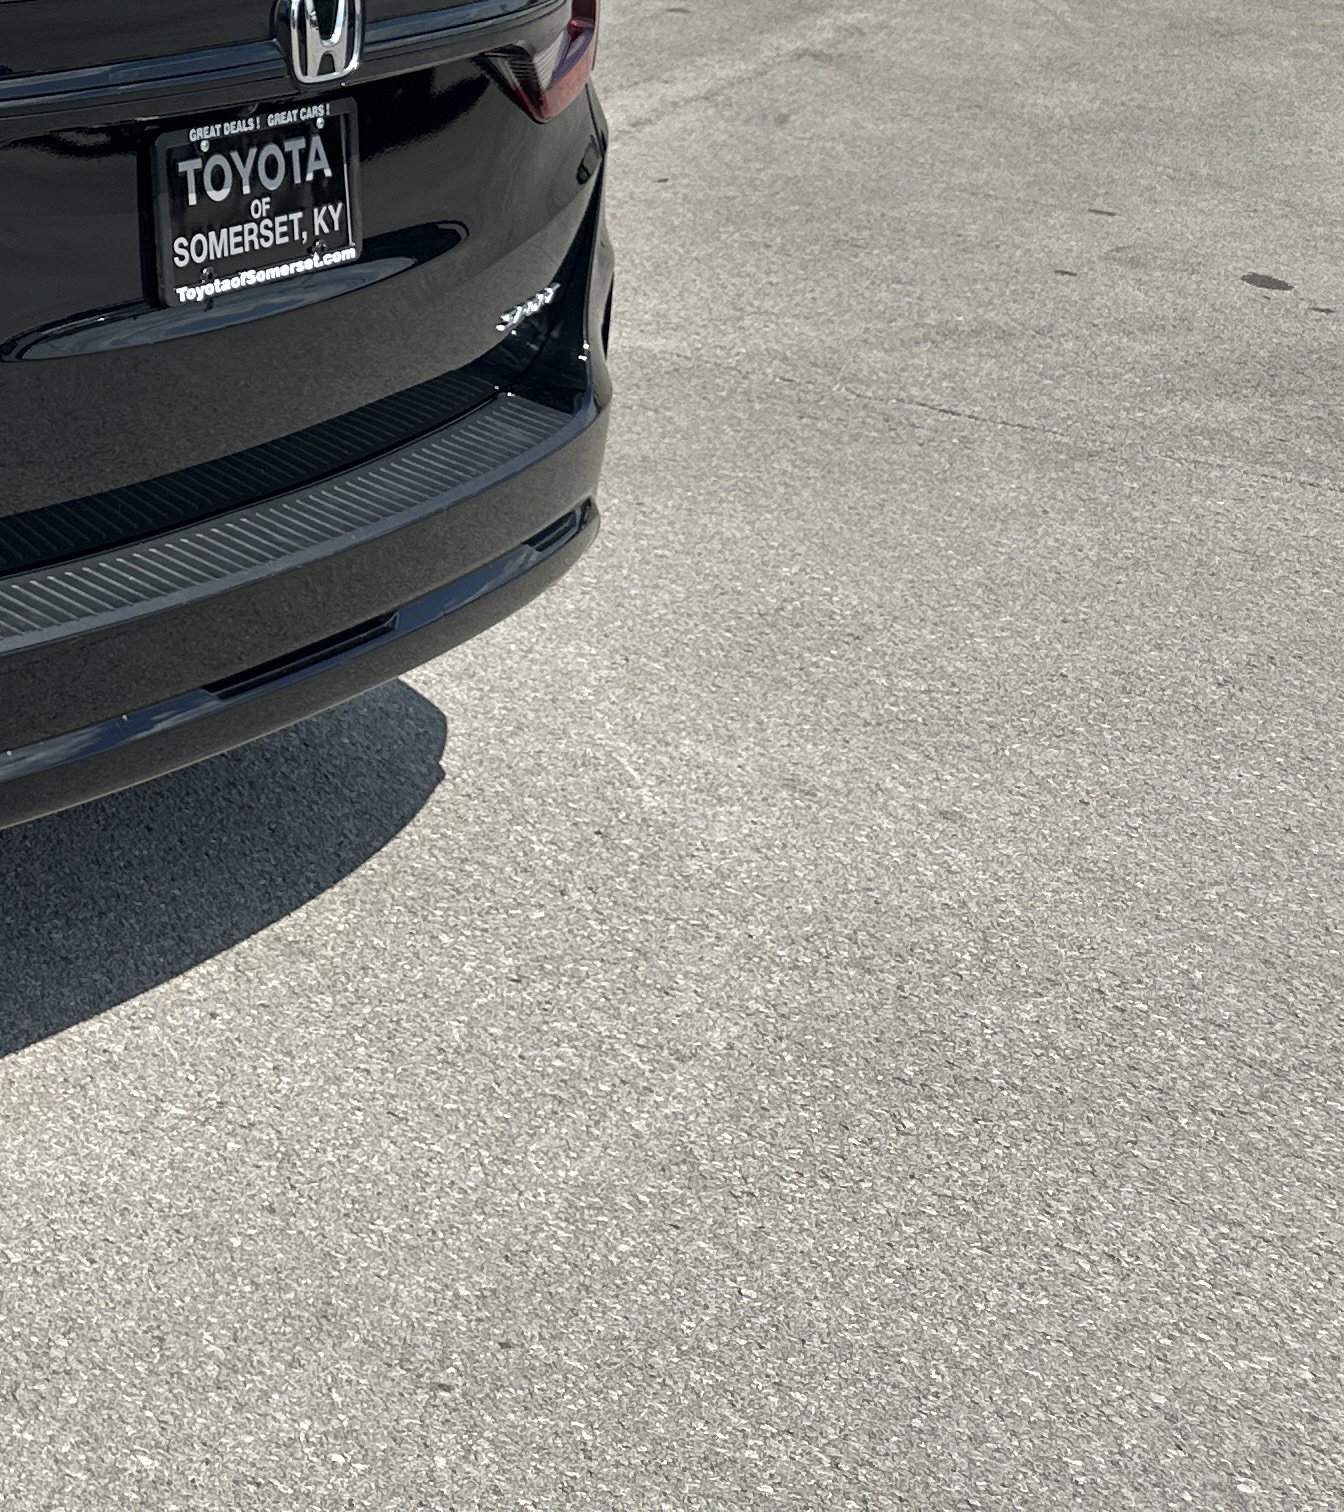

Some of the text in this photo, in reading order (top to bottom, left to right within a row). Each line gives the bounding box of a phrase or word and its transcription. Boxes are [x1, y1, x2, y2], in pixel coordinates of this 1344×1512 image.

[189, 123, 221, 142] GREAT
[267, 112, 299, 127] GREAT
[178, 134, 333, 206] TOYOTA
[173, 202, 344, 268] SOMERSET, KY
[250, 197, 271, 219] OF
[176, 247, 357, 302] ToyotaofSomerset.com
